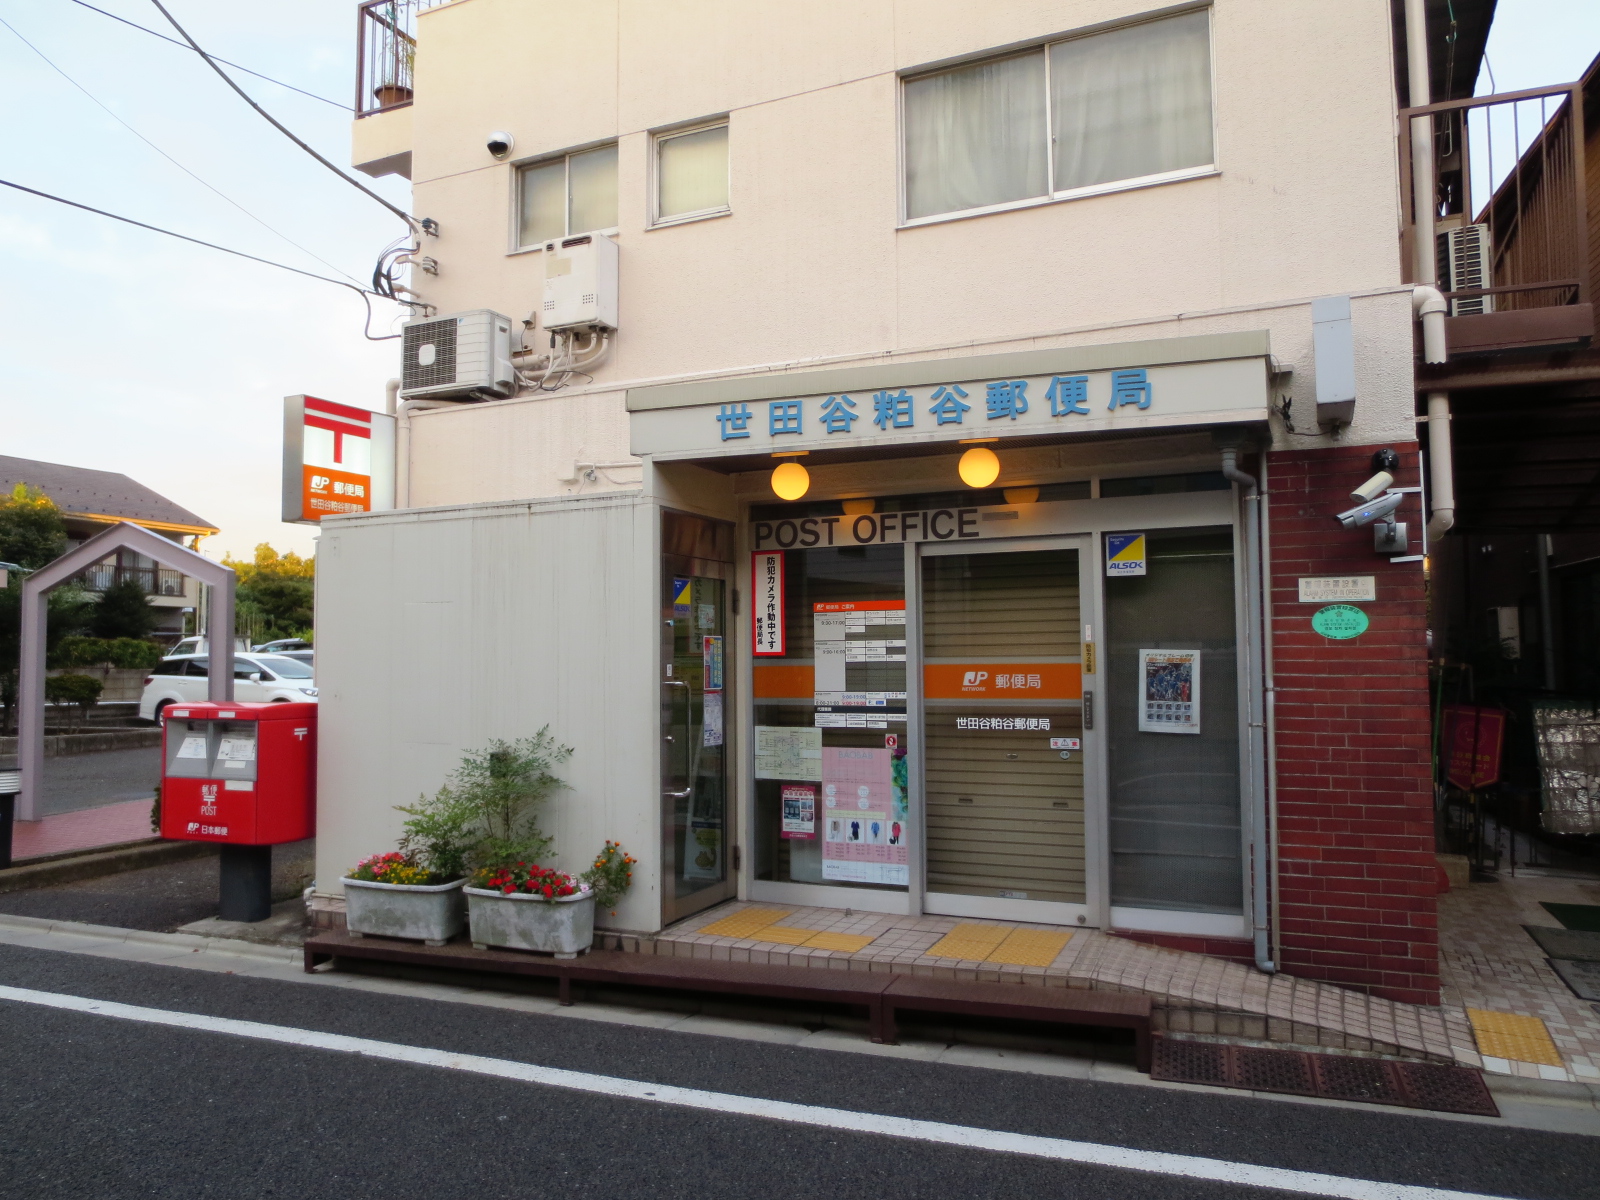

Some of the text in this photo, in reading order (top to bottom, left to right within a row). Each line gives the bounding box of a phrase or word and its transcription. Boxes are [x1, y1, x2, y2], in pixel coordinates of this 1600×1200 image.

[716, 369, 1152, 441] 世田谷粕谷郵便局
[333, 481, 365, 498] 郵便局
[310, 497, 364, 513] 世田谷粕谷郵便局
[754, 508, 979, 549] POST OFFICE
[1109, 561, 1144, 570] ALSOK
[767, 557, 776, 650] 防犯カメラ作動中です
[995, 674, 1041, 689] 郵便局
[956, 717, 1050, 730] 世田谷粕谷郵便局
[838, 751, 873, 760] BAOBAB
[202, 785, 217, 796] 郵便
[201, 806, 217, 816] POST
[202, 825, 228, 836] 日本郵便
